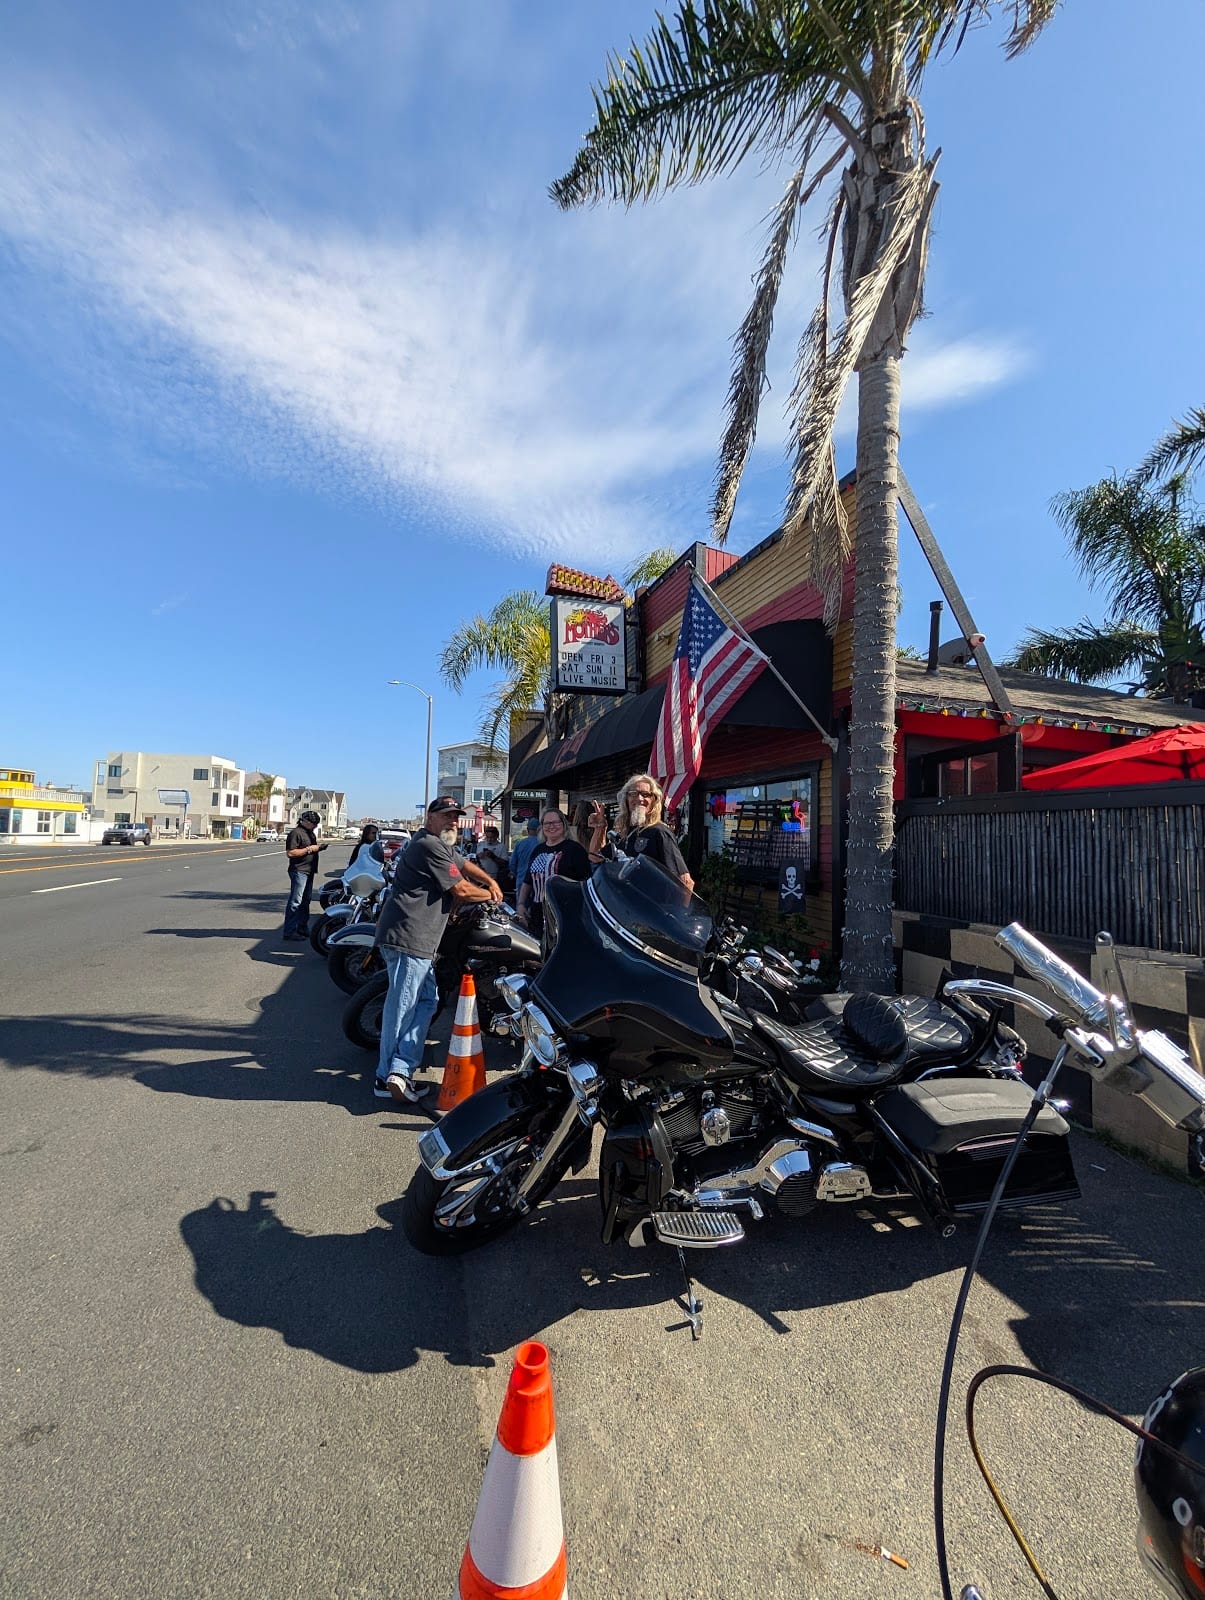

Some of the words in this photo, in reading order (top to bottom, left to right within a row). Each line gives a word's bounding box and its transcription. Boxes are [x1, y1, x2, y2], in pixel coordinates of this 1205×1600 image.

[561, 652, 583, 662] OPEN
[590, 654, 604, 664] FRI
[611, 656, 616, 665] 3
[561, 663, 579, 673] SAT
[586, 664, 602, 674] SUN
[563, 674, 584, 684] LIVE
[591, 676, 617, 686] MUSIC
